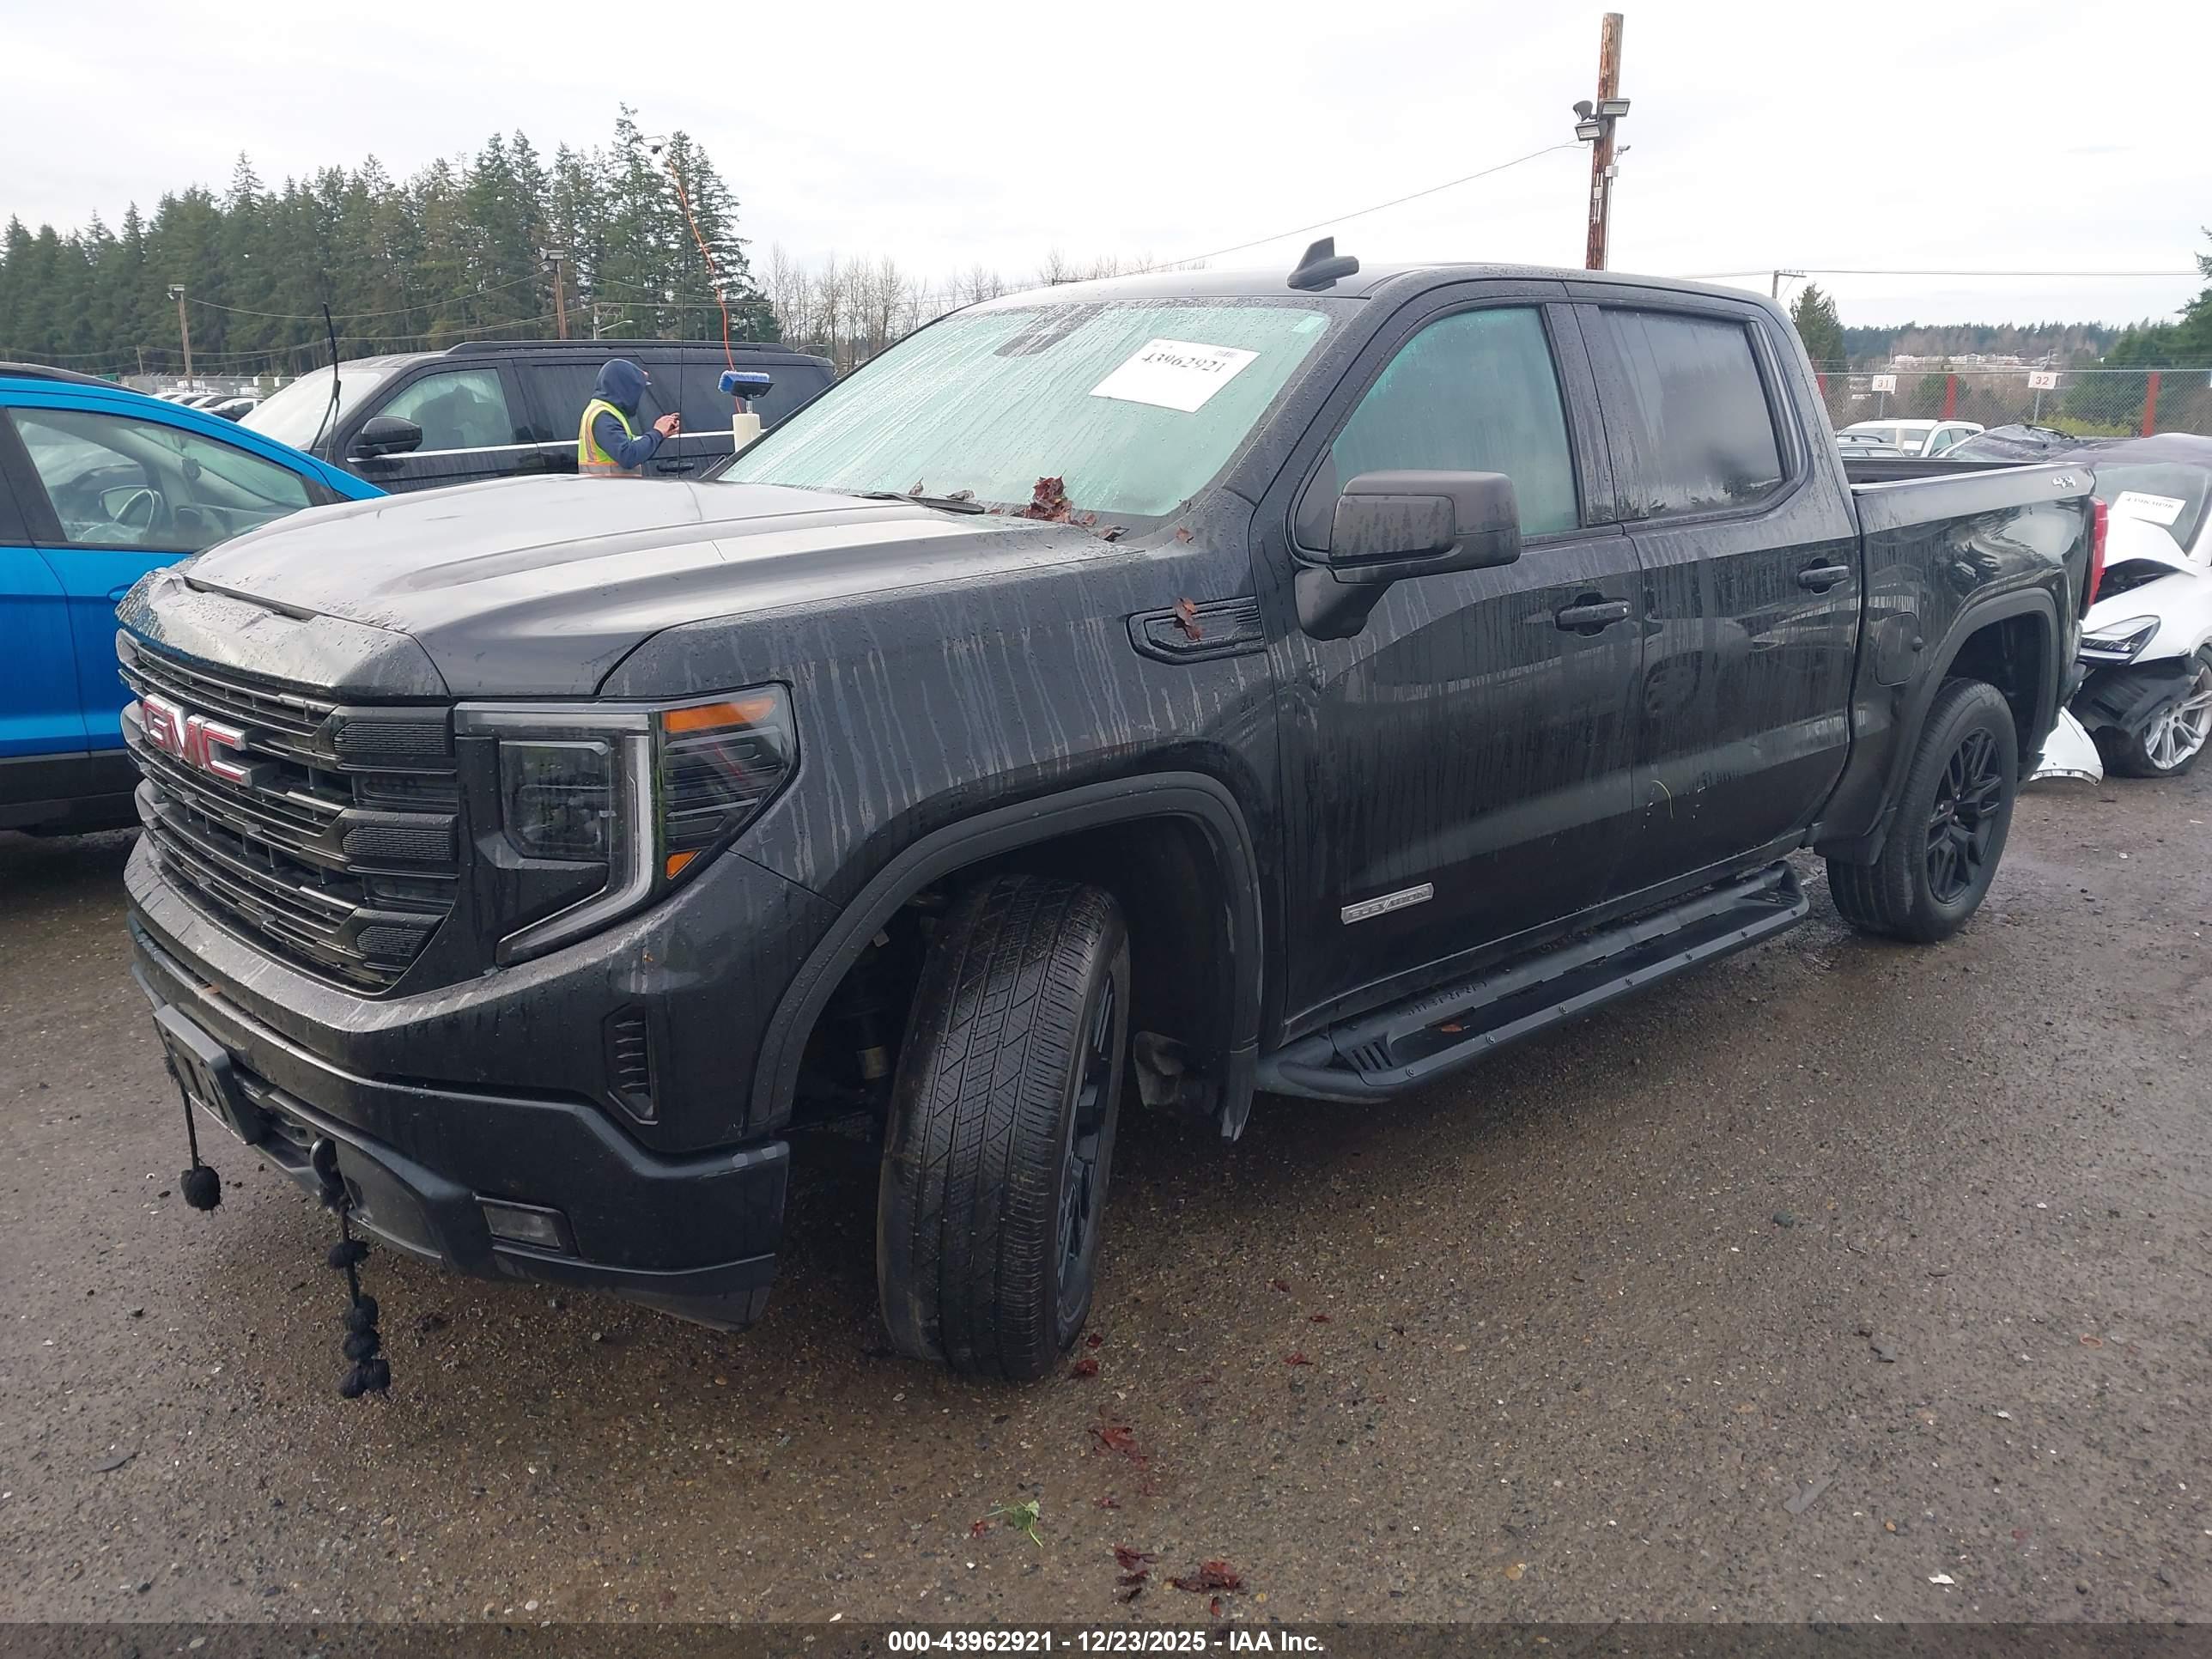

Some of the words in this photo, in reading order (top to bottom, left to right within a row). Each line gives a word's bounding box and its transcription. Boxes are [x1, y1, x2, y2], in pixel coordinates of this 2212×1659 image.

[1141, 352, 1226, 373] 43962921
[1877, 380, 1889, 388] 31
[2035, 376, 2049, 386] 32
[142, 693, 252, 788] GMC
